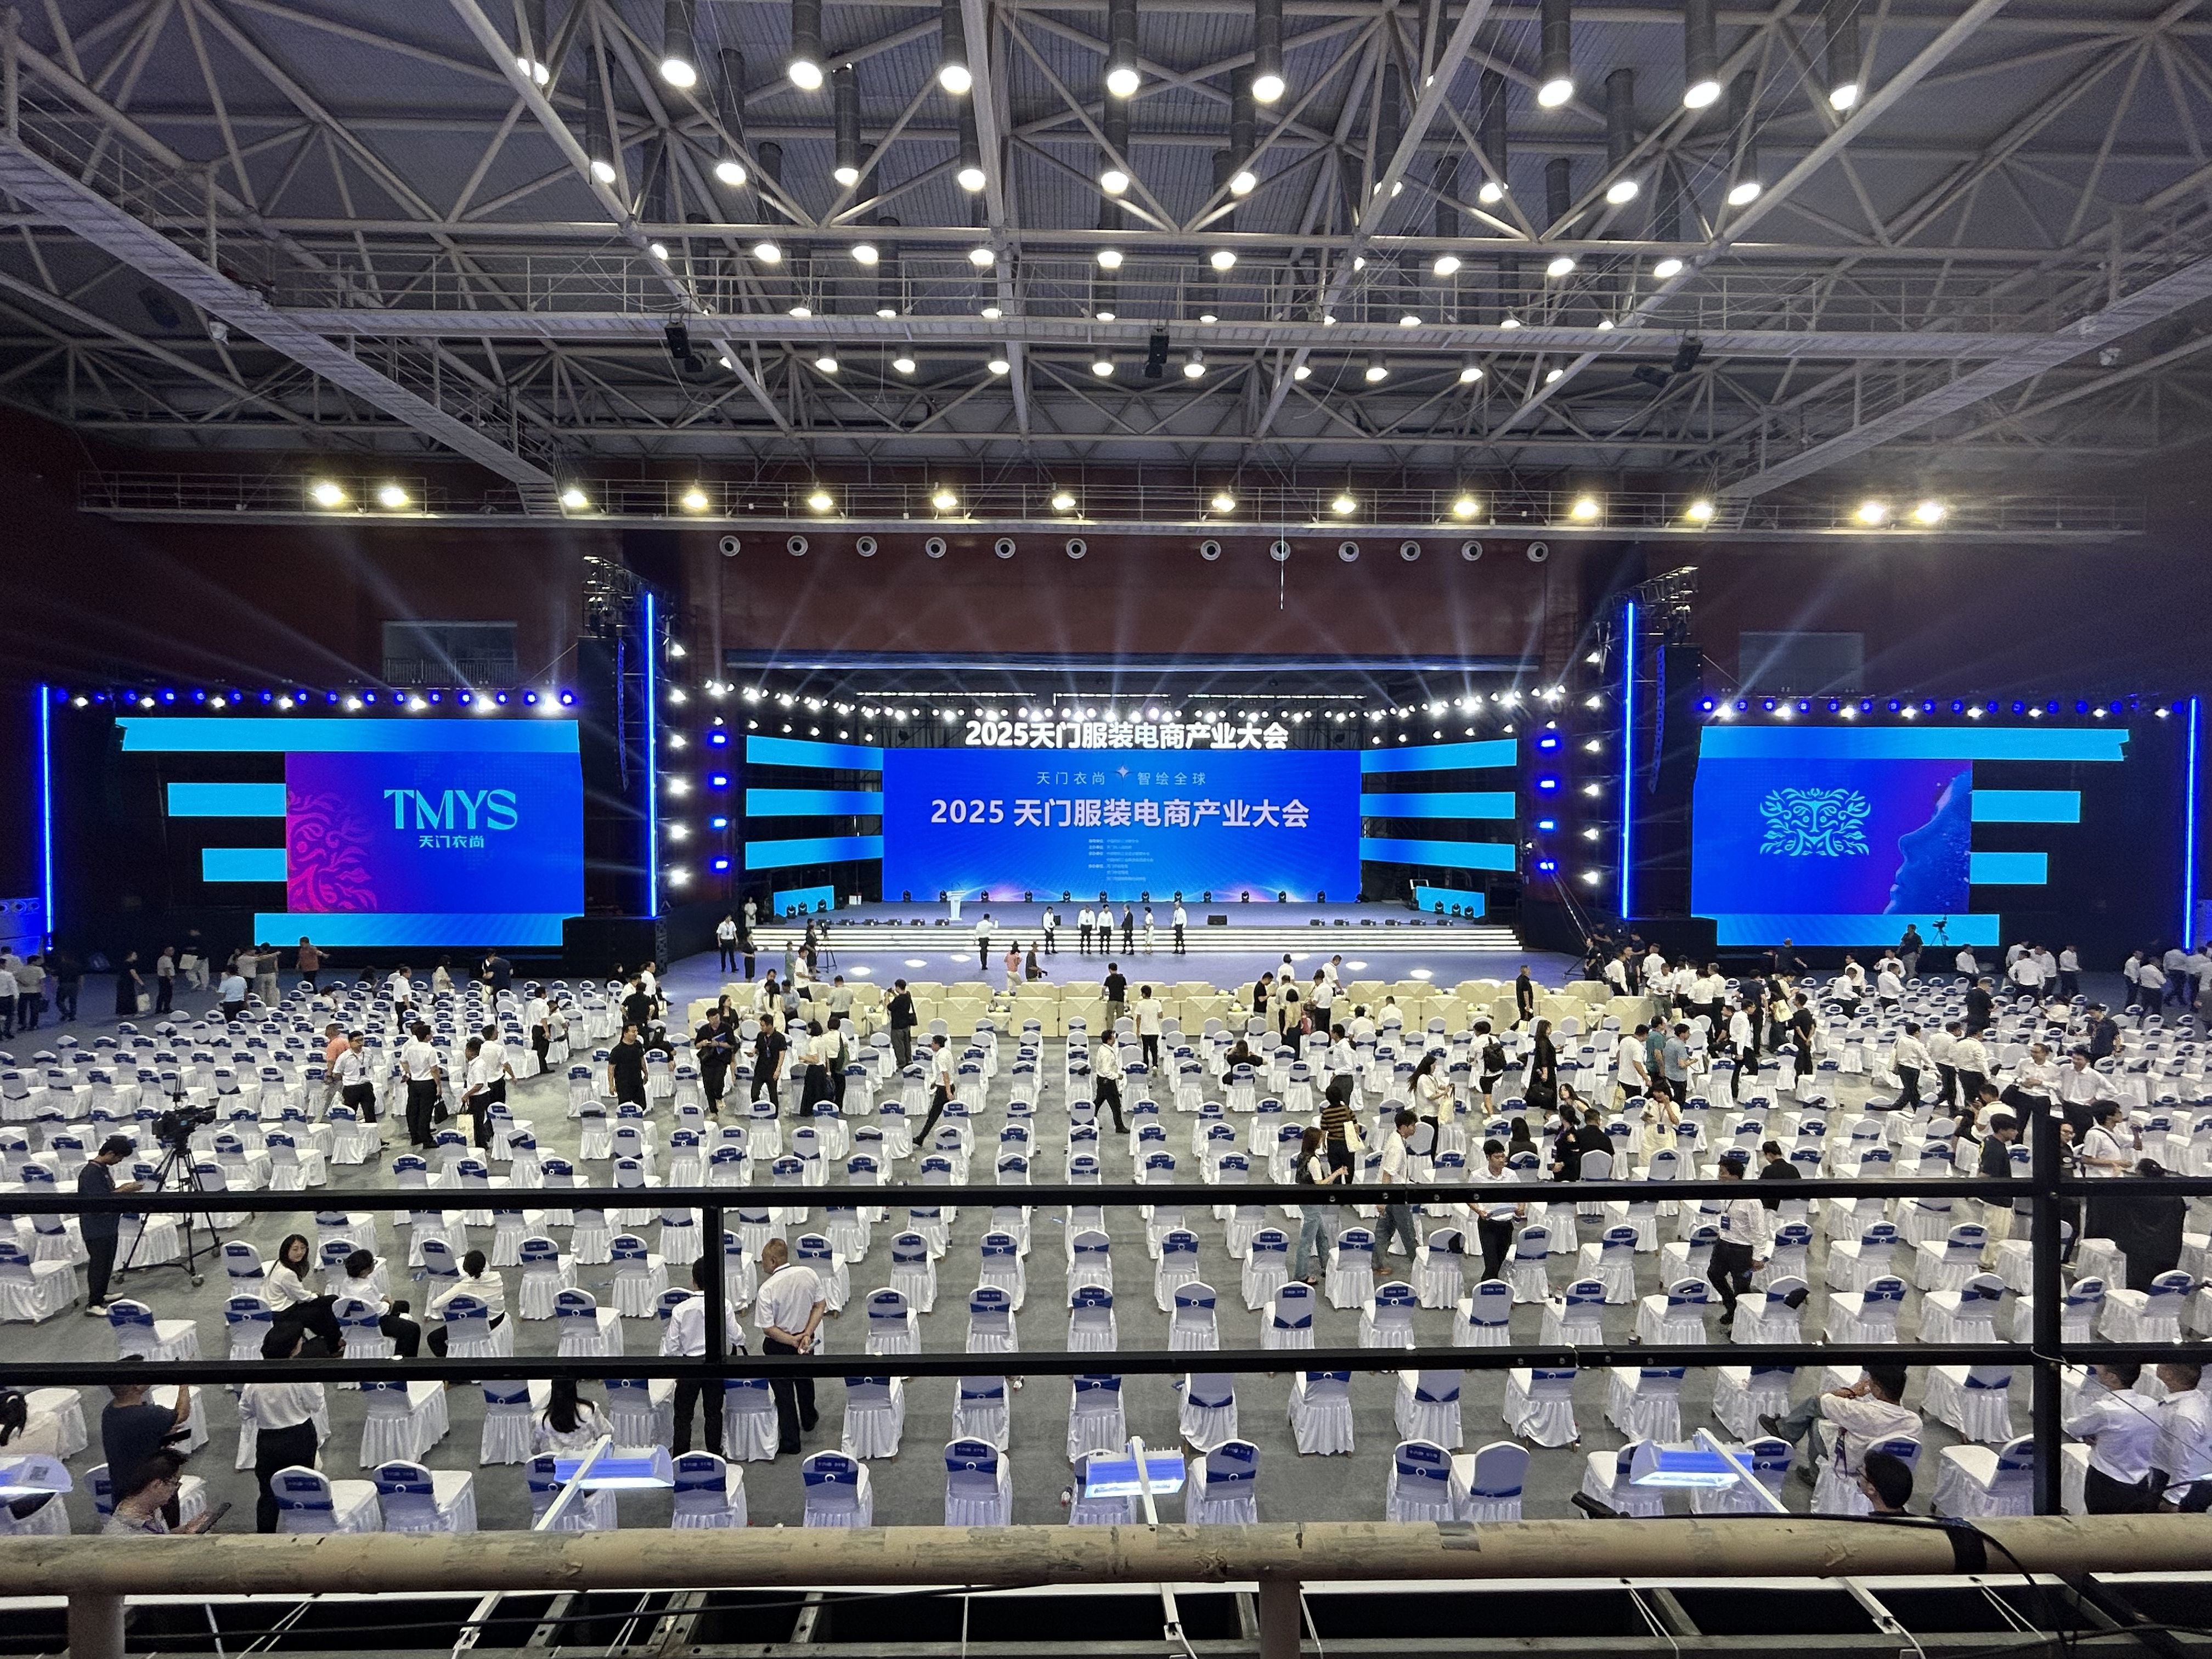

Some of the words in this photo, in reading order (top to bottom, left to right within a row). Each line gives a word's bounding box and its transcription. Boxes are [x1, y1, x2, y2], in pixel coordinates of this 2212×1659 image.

[965, 720, 1289, 749] 2025天门服装电商产业大会
[1036, 771, 1105, 785] 天门衣尚
[1137, 771, 1206, 786] 智绘全球
[384, 789, 518, 830] TMYS
[932, 799, 1004, 823] 2025
[1014, 798, 1310, 828] 天门服装电商产业大会
[419, 835, 484, 848] 天门衣尚
